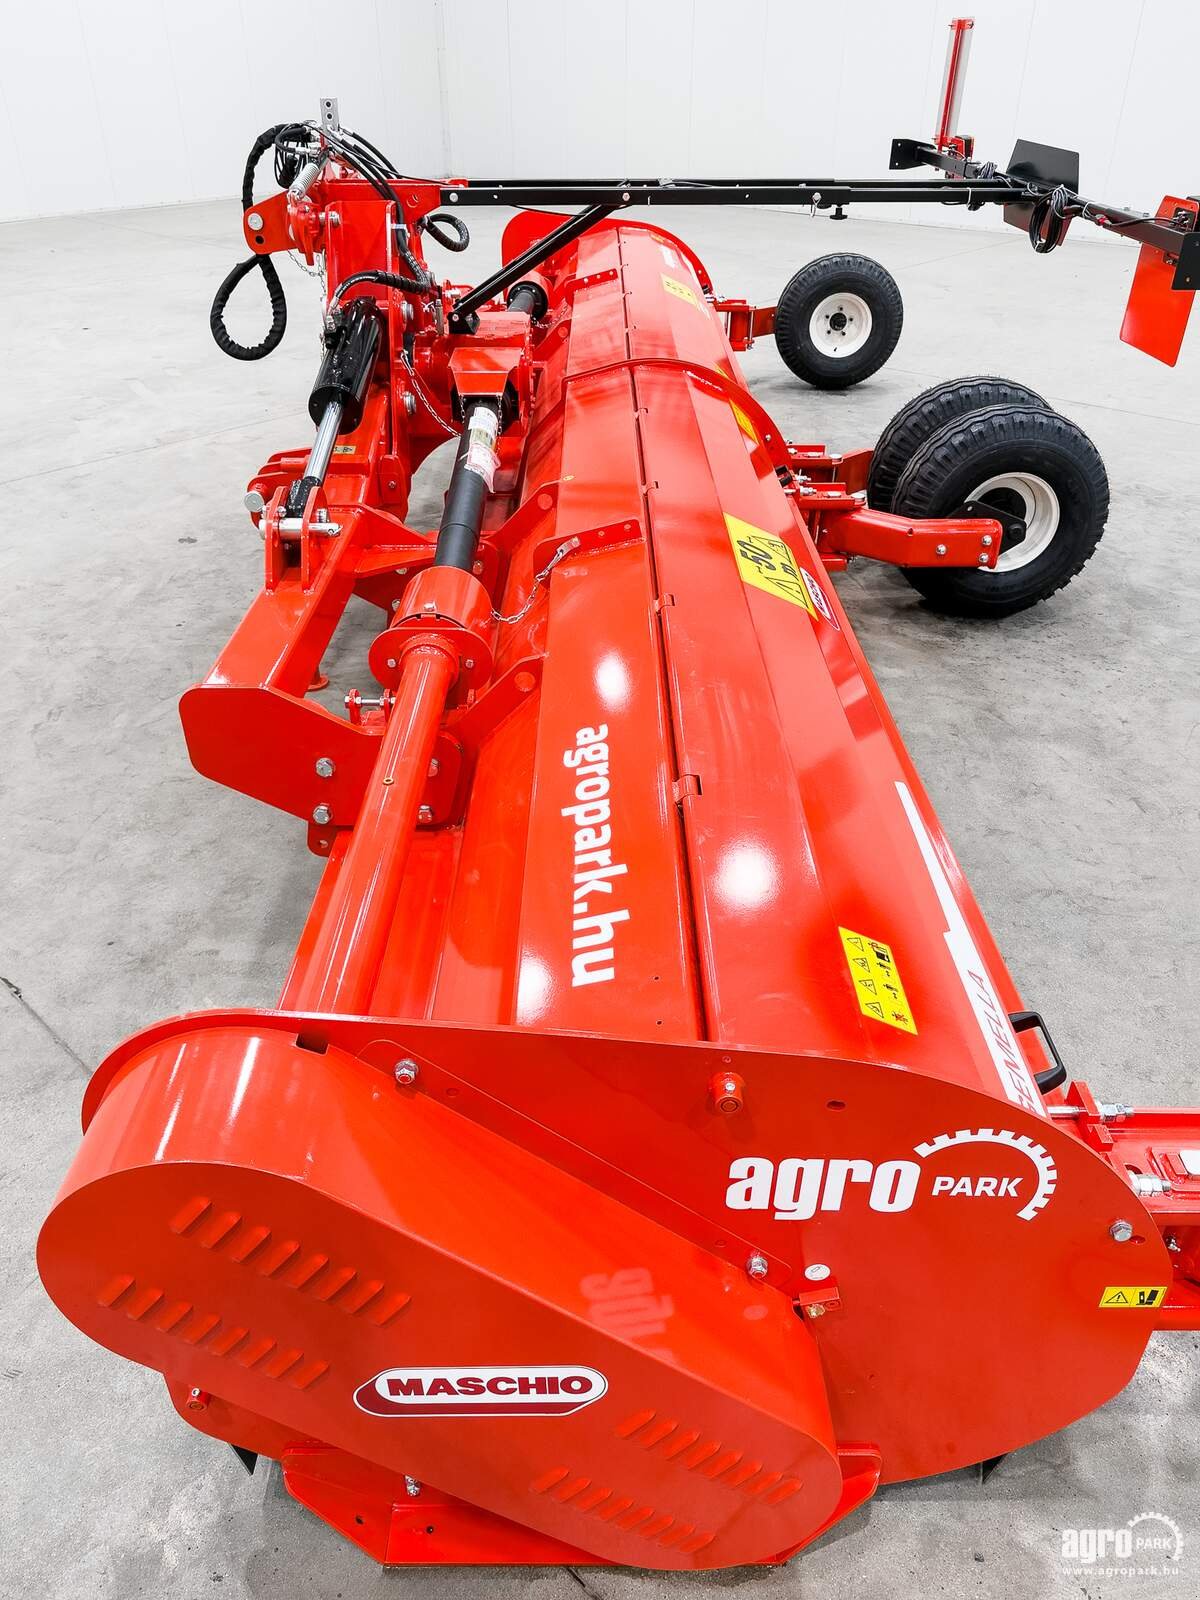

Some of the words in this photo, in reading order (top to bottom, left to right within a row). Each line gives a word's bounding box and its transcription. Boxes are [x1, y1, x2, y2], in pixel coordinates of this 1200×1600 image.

[737, 539, 776, 572] 50
[561, 723, 631, 988] agropark.hu
[725, 1156, 921, 1220] agro
[931, 1175, 1023, 1198] PARK
[386, 1376, 593, 1397] MASCHIO
